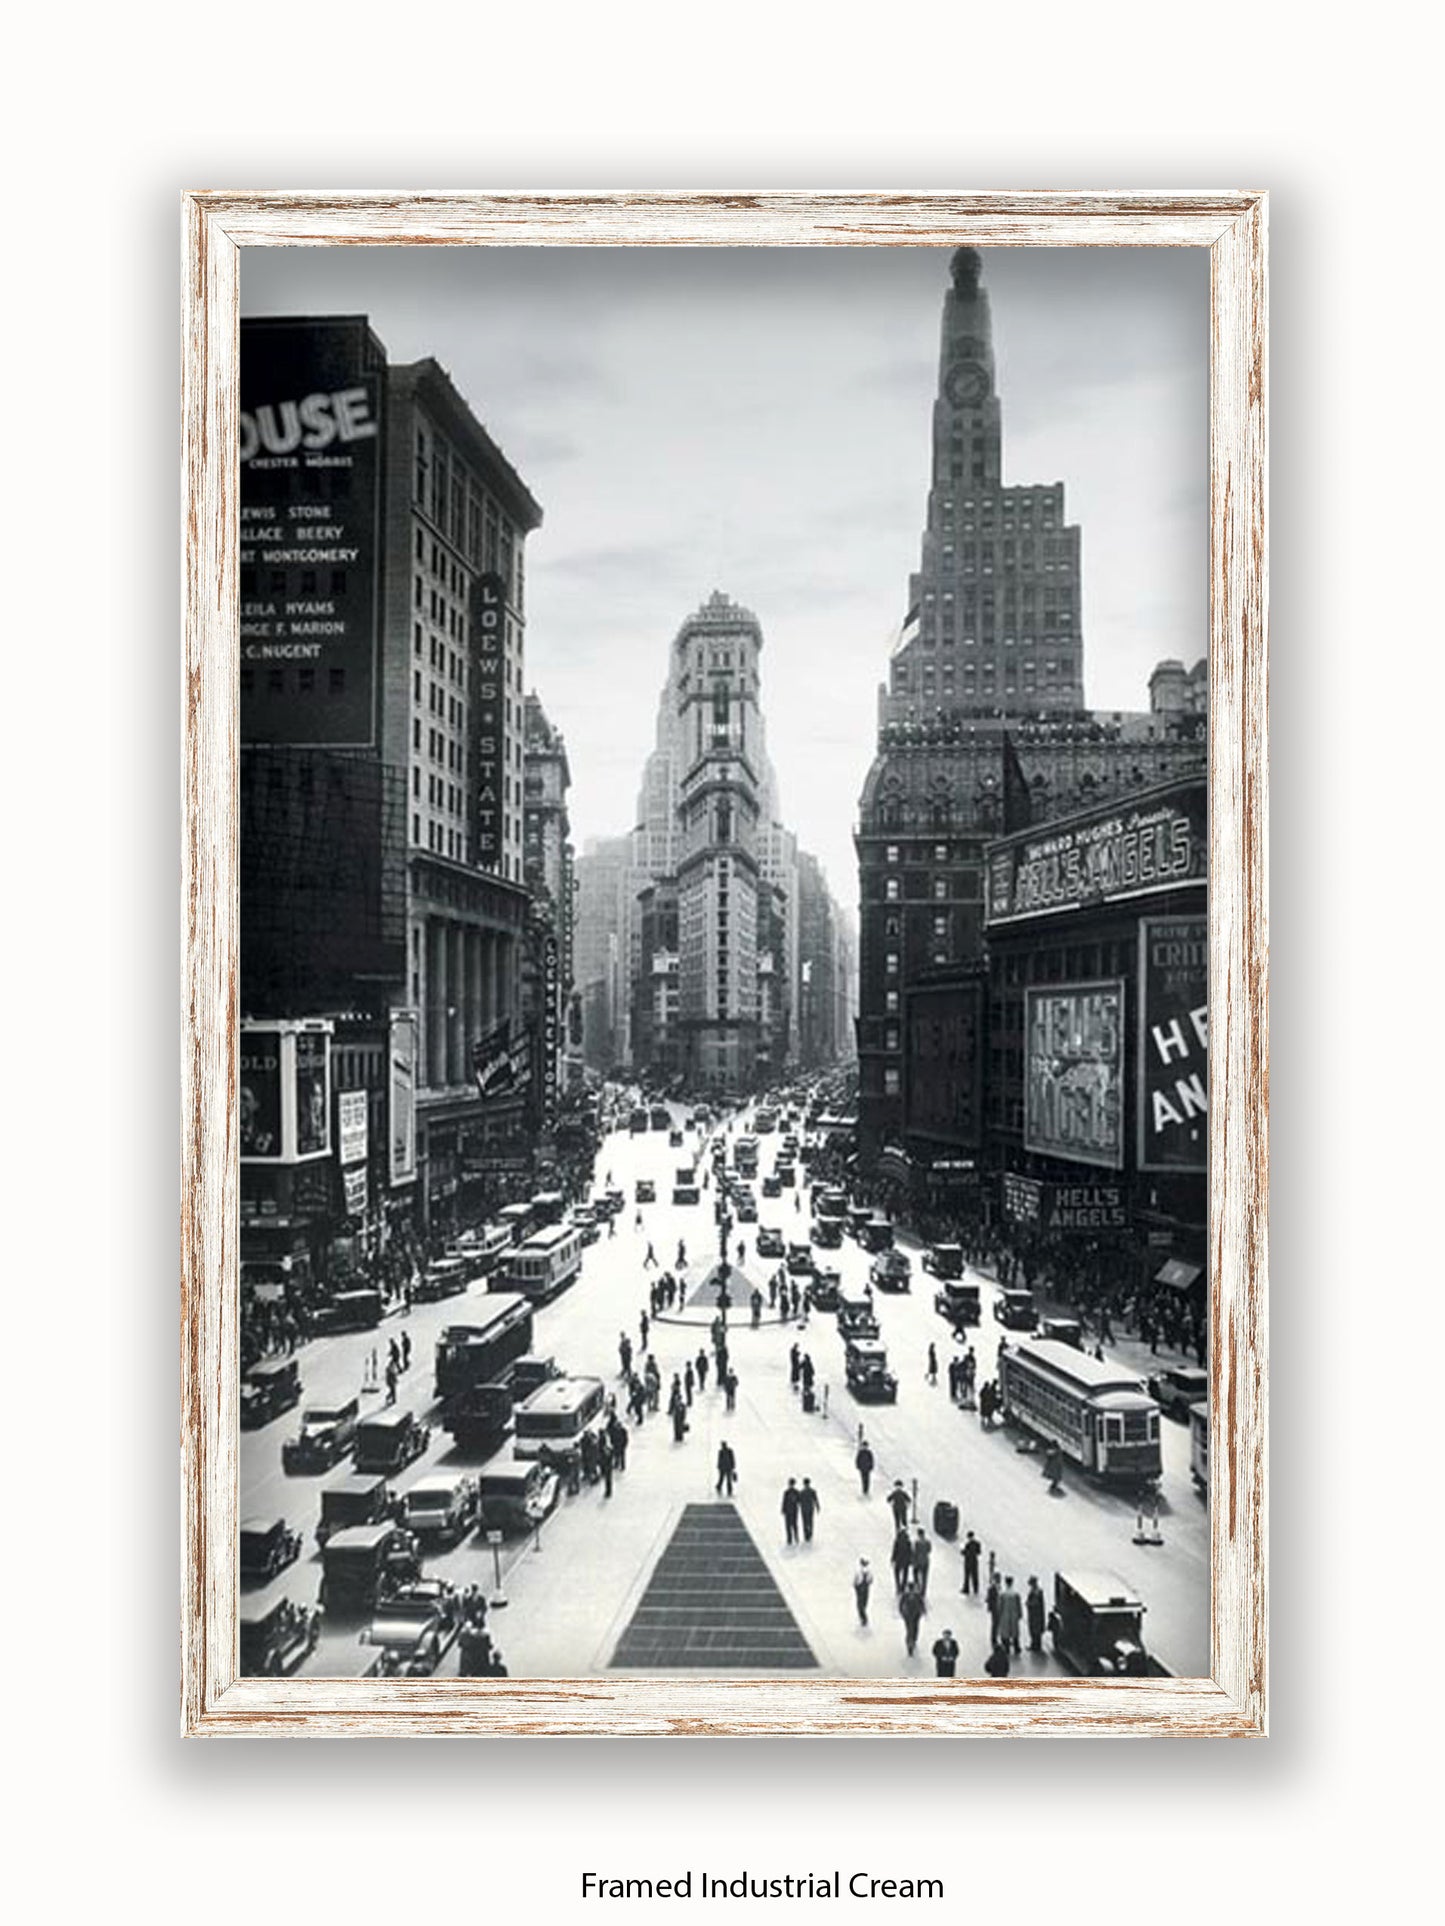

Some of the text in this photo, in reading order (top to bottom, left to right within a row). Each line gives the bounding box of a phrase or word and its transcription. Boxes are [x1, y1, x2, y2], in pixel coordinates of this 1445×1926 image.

[240, 506, 331, 519] EWIS STONE
[297, 526, 344, 541] BEERY
[262, 549, 359, 562] MONTGOMERY
[286, 602, 335, 614] HYAMS
[291, 621, 344, 634] MARION
[479, 587, 498, 850] LOEWS STATE
[1152, 1073, 1207, 1133] AN
[1050, 1208, 1125, 1227] ANGELS
